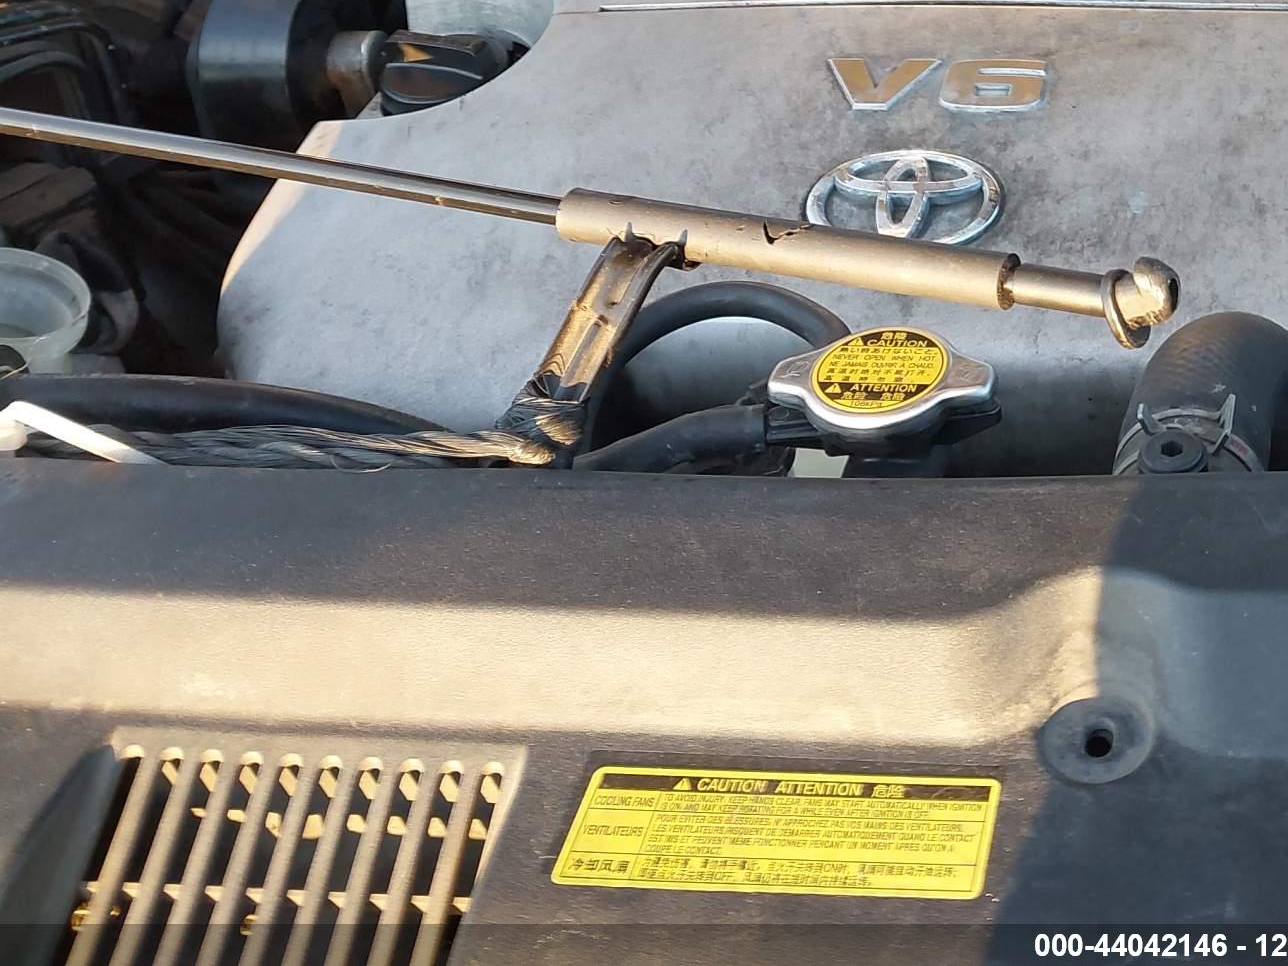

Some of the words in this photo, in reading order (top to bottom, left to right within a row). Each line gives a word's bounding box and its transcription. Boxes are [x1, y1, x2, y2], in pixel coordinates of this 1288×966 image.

[827, 57, 1048, 112] V6
[866, 339, 928, 347] CAUTION
[849, 383, 918, 393] ATTENTION
[697, 778, 768, 793] CAUTION
[774, 780, 866, 796] ATTENTION
[594, 795, 632, 806] COOLING
[632, 796, 655, 807] FANS
[664, 793, 672, 802] TO
[674, 794, 697, 803] AVOID
[727, 795, 748, 804] KEEP
[749, 796, 775, 805] HANDS
[803, 798, 821, 807] FANS
[826, 799, 841, 807] MAY
[842, 799, 865, 808] START
[866, 800, 926, 810] AUTOMATICALLY
[927, 802, 948, 811] WHEN
[949, 803, 983, 812] IGNITION
[701, 804, 716, 812] MAY
[719, 804, 738, 813] KEEP
[658, 814, 677, 823] POUR
[679, 815, 706, 824] EVITER
[830, 820, 846, 829] PAS
[862, 821, 888, 830] MAINS
[583, 824, 644, 837] VENTILATEURS
[653, 824, 667, 833] LES
[668, 824, 724, 834] VENTILATEURS
[726, 826, 764, 836] RISQUENT
[822, 830, 897, 841] AUTOMATIQUEMENT
[898, 832, 925, 842] QUAND
[939, 833, 976, 843] CONTACT
[693, 835, 729, 845] PEUVENT
[752, 837, 807, 848] FONCTIONNER
[808, 839, 847, 849] PENDANT
[859, 841, 894, 851] MOMENT
[895, 842, 921, 852] APRES
